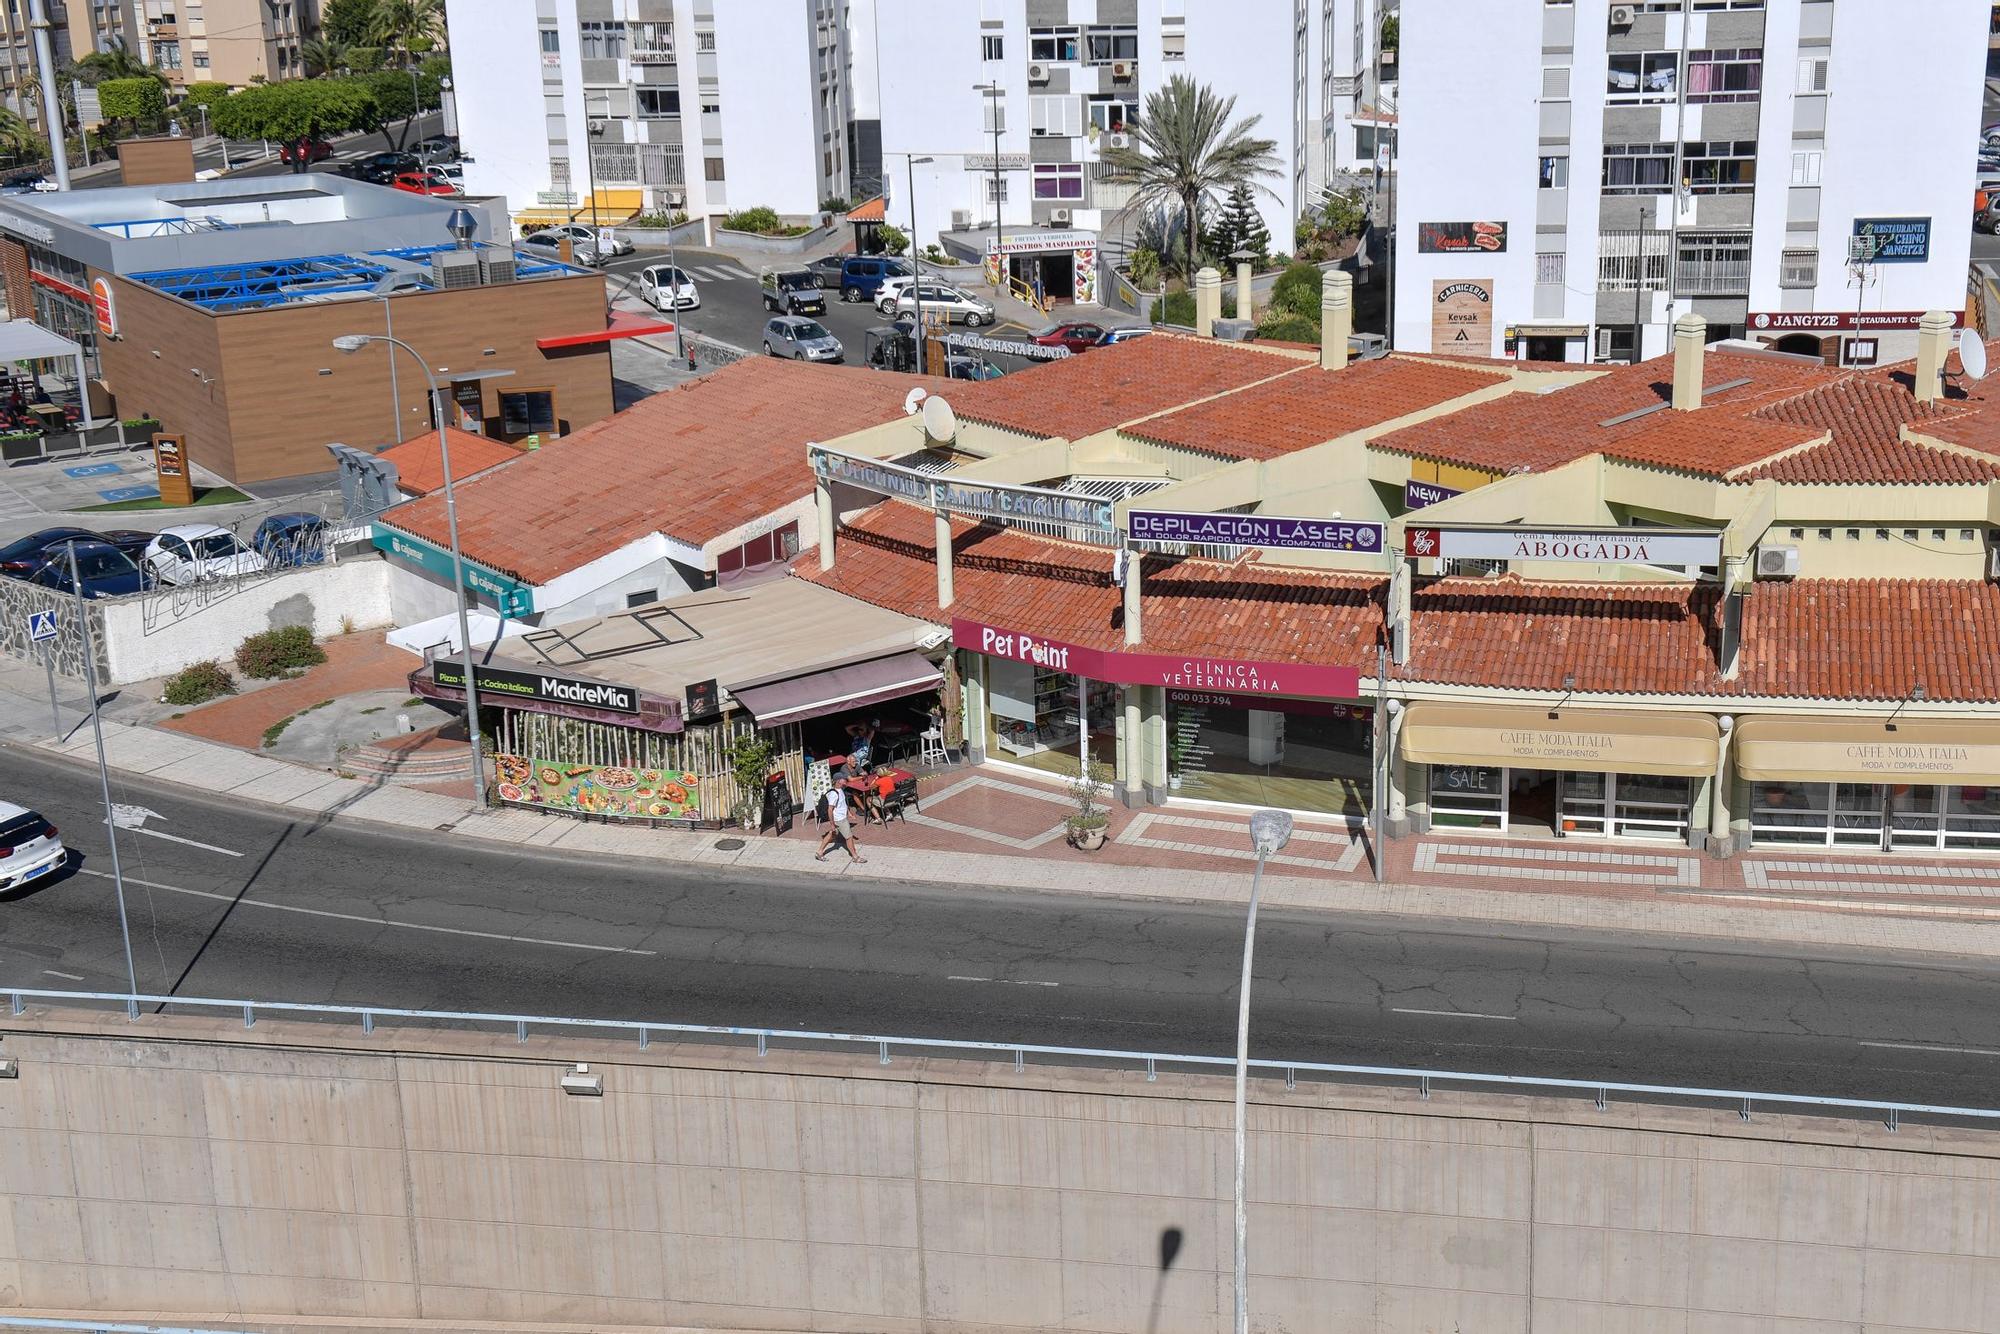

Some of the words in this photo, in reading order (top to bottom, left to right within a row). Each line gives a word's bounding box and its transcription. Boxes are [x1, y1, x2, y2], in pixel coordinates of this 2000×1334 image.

[1873, 223, 1926, 233] RESTAURANTE
[993, 243, 1044, 251] SMINISTROS
[1045, 239, 1096, 249] MASPALOMAS
[1895, 234, 1926, 244] CHINO
[1883, 244, 1924, 255] JANGTZE
[1448, 313, 1478, 321] Kevsak
[1773, 315, 1839, 326] JANGTZE
[1849, 316, 1908, 324] RESTAURANTE
[948, 333, 993, 352] GRACIAS,
[993, 341, 1024, 355] HASTA
[1026, 344, 1070, 360] PRONTO
[1409, 485, 1441, 502] NEW
[935, 485, 994, 509] SANTA
[1000, 494, 1094, 524] CATALINA
[1133, 517, 1270, 537] DEPILACIÓN
[1276, 520, 1354, 541] LÁSER
[1513, 531, 1545, 540] Gema
[1552, 532, 1582, 542] Rojas
[1235, 537, 1270, 545] EFICAZ
[1281, 540, 1345, 549] COMPATIBLE
[1515, 541, 1649, 560] ABOGADA
[982, 627, 1014, 657] Pet
[1019, 635, 1069, 670] Point
[1183, 661, 1258, 677] CLÍNICA
[439, 673, 458, 683] Pizza
[484, 679, 508, 690] Cocina
[1163, 673, 1280, 691] VETERINARIA
[541, 677, 629, 708] MadreMia
[1171, 691, 1190, 701] 600
[1192, 693, 1210, 704] 033
[1213, 695, 1232, 706] 294
[1539, 733, 1573, 746] MODA
[1577, 735, 1613, 749] ITALIA
[1543, 748, 1599, 758] COMPLEMENTOS
[1888, 746, 1925, 759] MODA
[1929, 747, 1968, 760] ITALIA
[1861, 761, 1884, 769] MODA
[1894, 762, 1954, 771] COMPLEMENTOS
[1448, 770, 1488, 789] SALE
